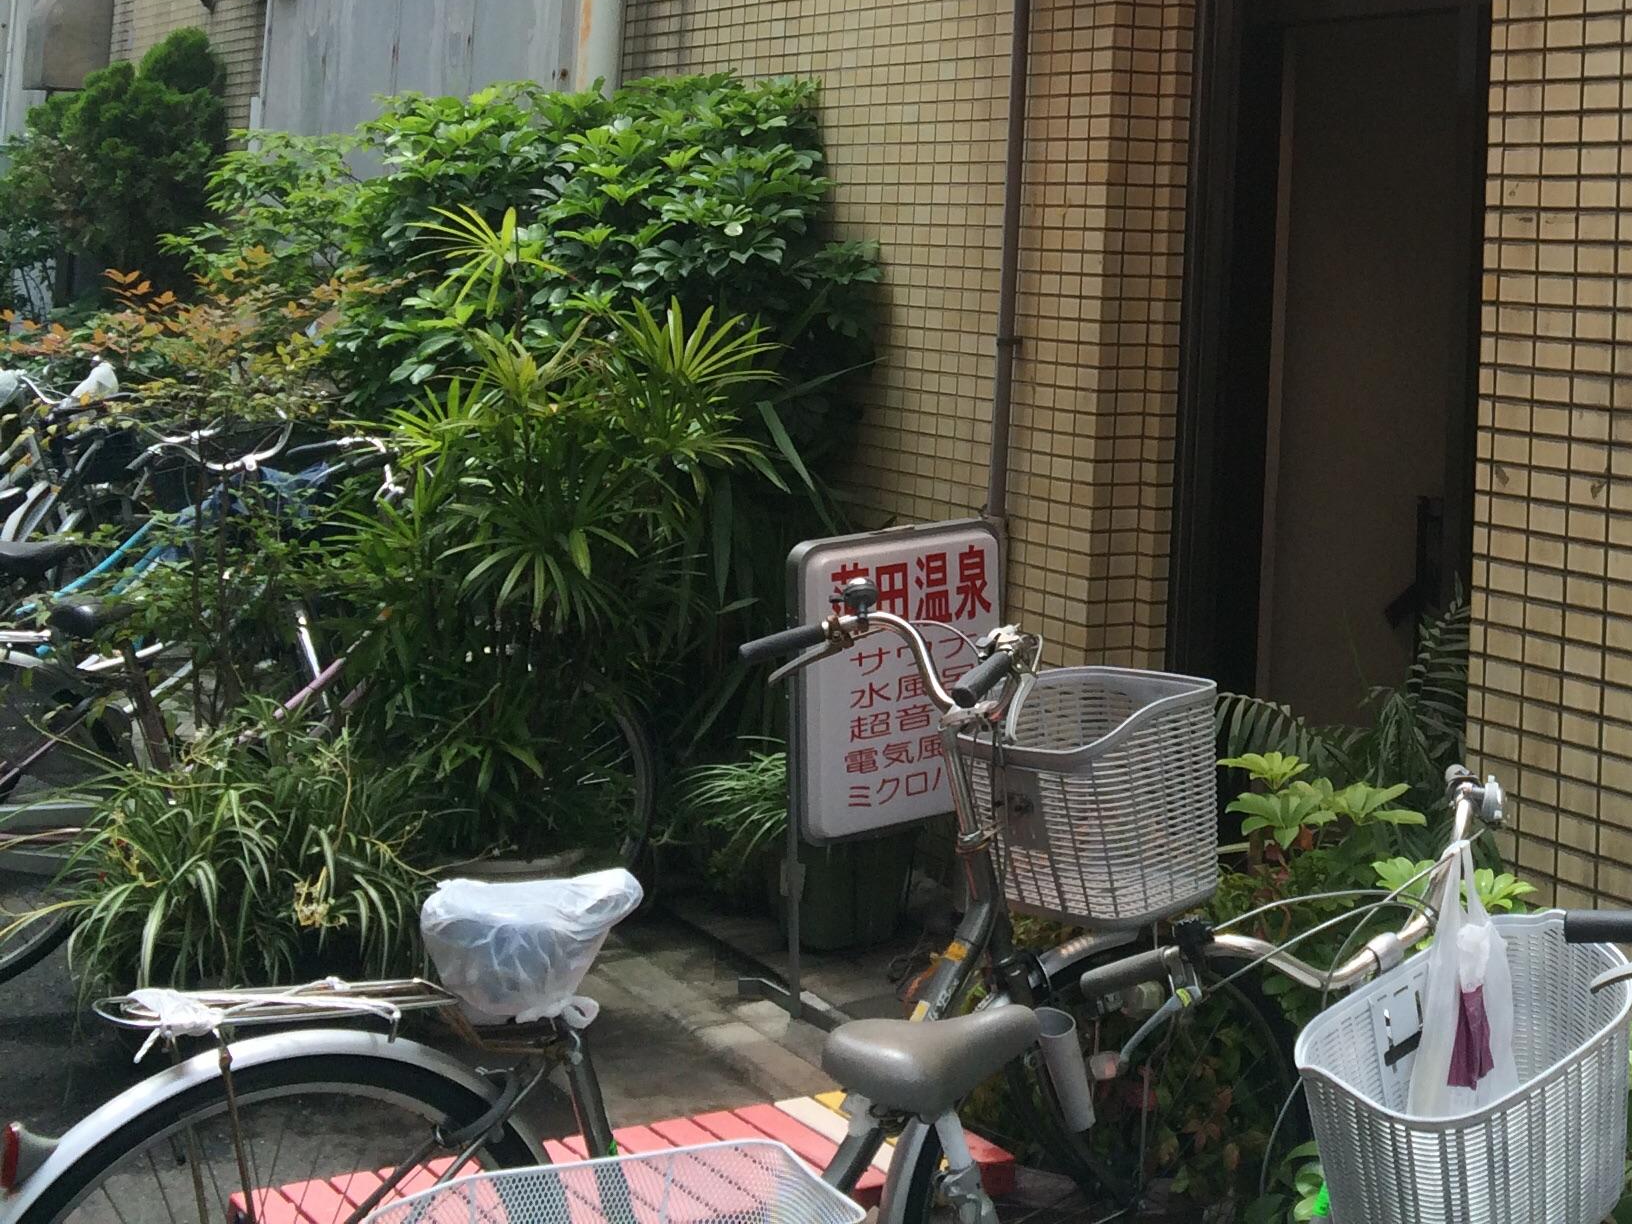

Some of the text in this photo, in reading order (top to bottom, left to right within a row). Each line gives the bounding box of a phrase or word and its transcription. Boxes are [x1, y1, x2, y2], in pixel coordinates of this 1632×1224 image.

[850, 703, 935, 743] 超音
[844, 733, 944, 774] 電気風
